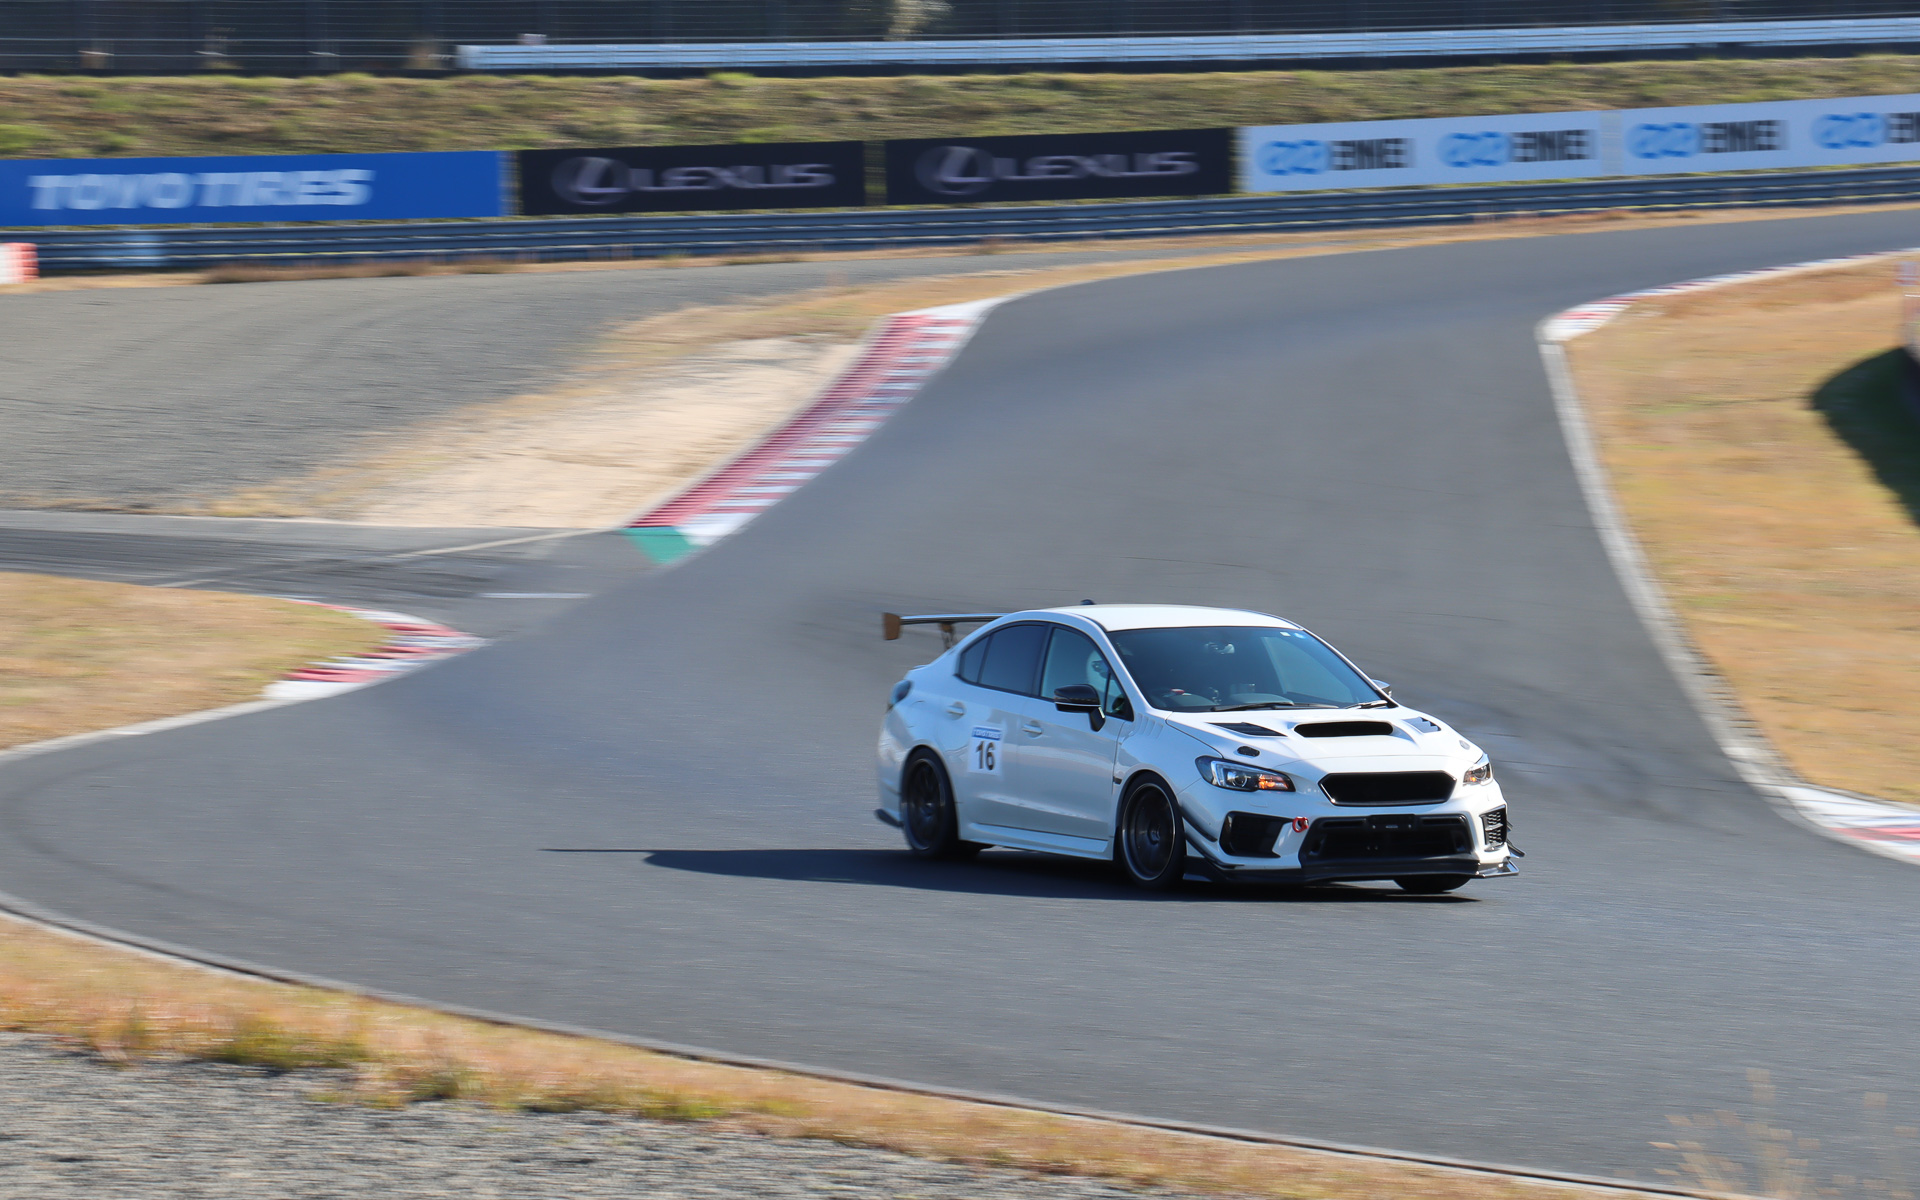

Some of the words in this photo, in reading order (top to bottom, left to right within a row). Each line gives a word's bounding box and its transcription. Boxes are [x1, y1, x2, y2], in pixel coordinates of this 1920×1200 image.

[629, 163, 835, 191] LEXUS
[993, 151, 1199, 180] LEXUS
[28, 172, 193, 210] TOYO
[194, 169, 375, 206] TIRES
[976, 741, 995, 770] 16
